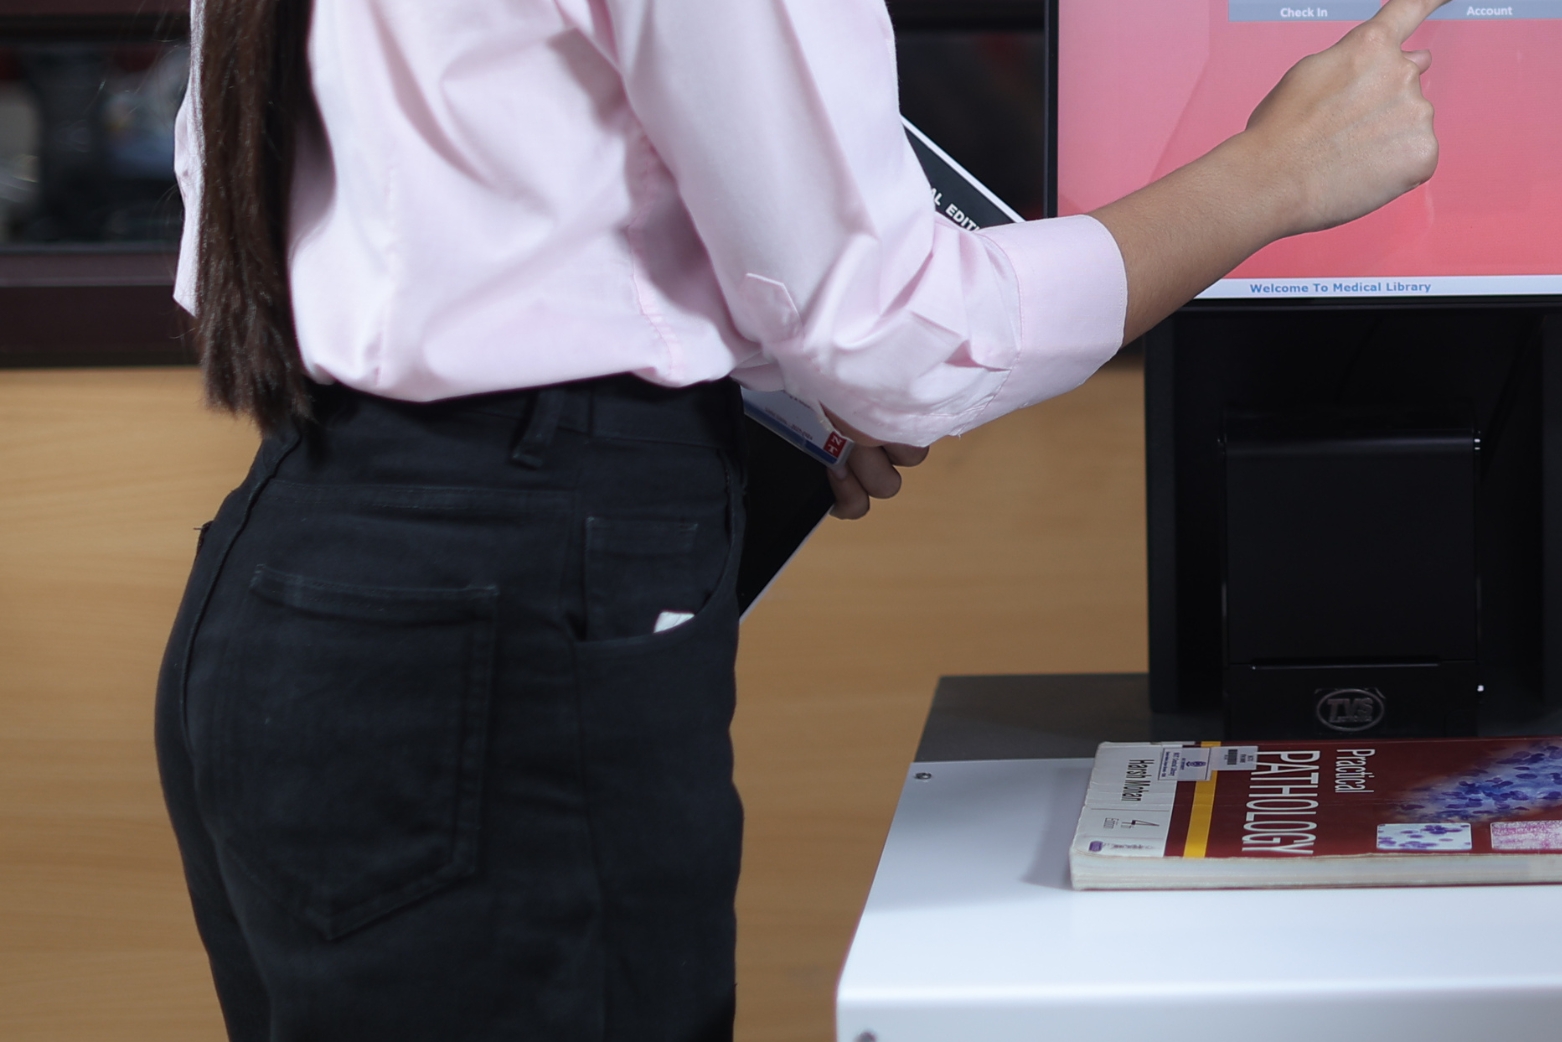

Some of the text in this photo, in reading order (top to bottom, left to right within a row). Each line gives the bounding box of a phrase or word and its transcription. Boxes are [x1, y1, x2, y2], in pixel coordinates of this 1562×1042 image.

[1280, 7, 1328, 18] Check In
[1466, 6, 1513, 16] Account
[1250, 282, 1432, 293] Welcome To Medical Library
[1327, 697, 1373, 720] TVS
[1121, 759, 1155, 802] Harsh Mohan
[1335, 748, 1376, 793] Practical
[1242, 750, 1321, 855] PATHOLOGY
